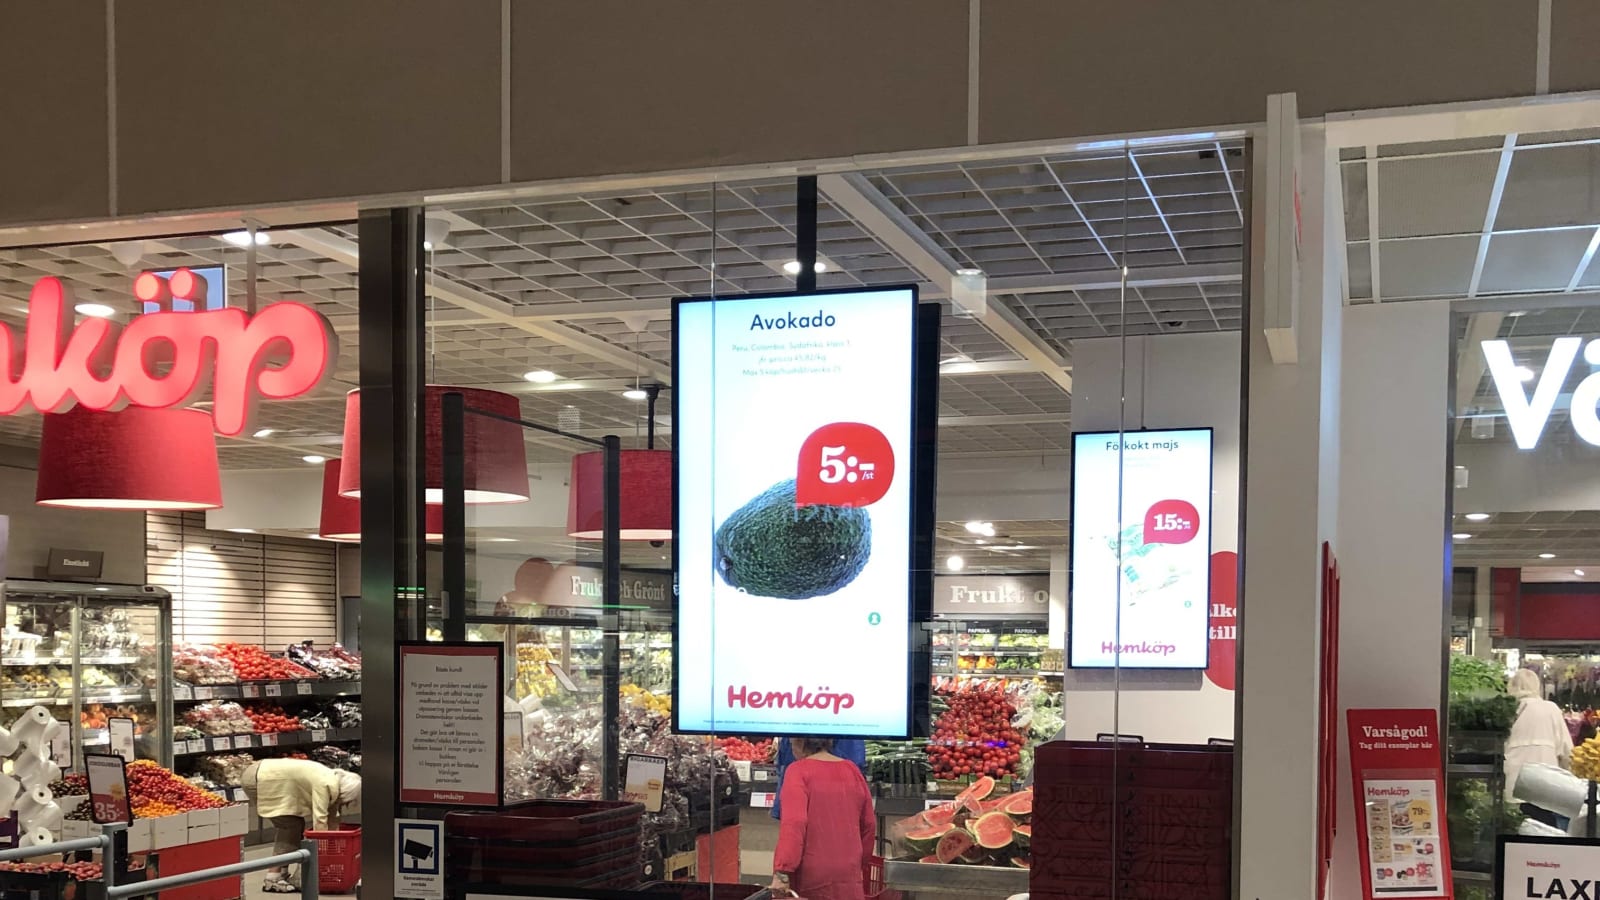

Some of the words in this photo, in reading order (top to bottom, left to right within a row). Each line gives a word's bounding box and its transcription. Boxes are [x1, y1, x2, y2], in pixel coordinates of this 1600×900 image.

[750, 310, 836, 331] Avokado
[0, 267, 331, 436] köp
[1106, 440, 1150, 451] Fökokt
[1152, 440, 1179, 452] majs
[819, 445, 875, 483] 5:-
[571, 575, 604, 596] Fruk
[634, 580, 666, 601] Grönt
[949, 585, 1025, 604] Frukt
[1101, 641, 1176, 656] Hemköp
[727, 685, 855, 715] Hemköp
[1361, 724, 1429, 741] Varsågod!
[1358, 742, 1373, 750] Tag
[1367, 786, 1410, 797] Hemköp
